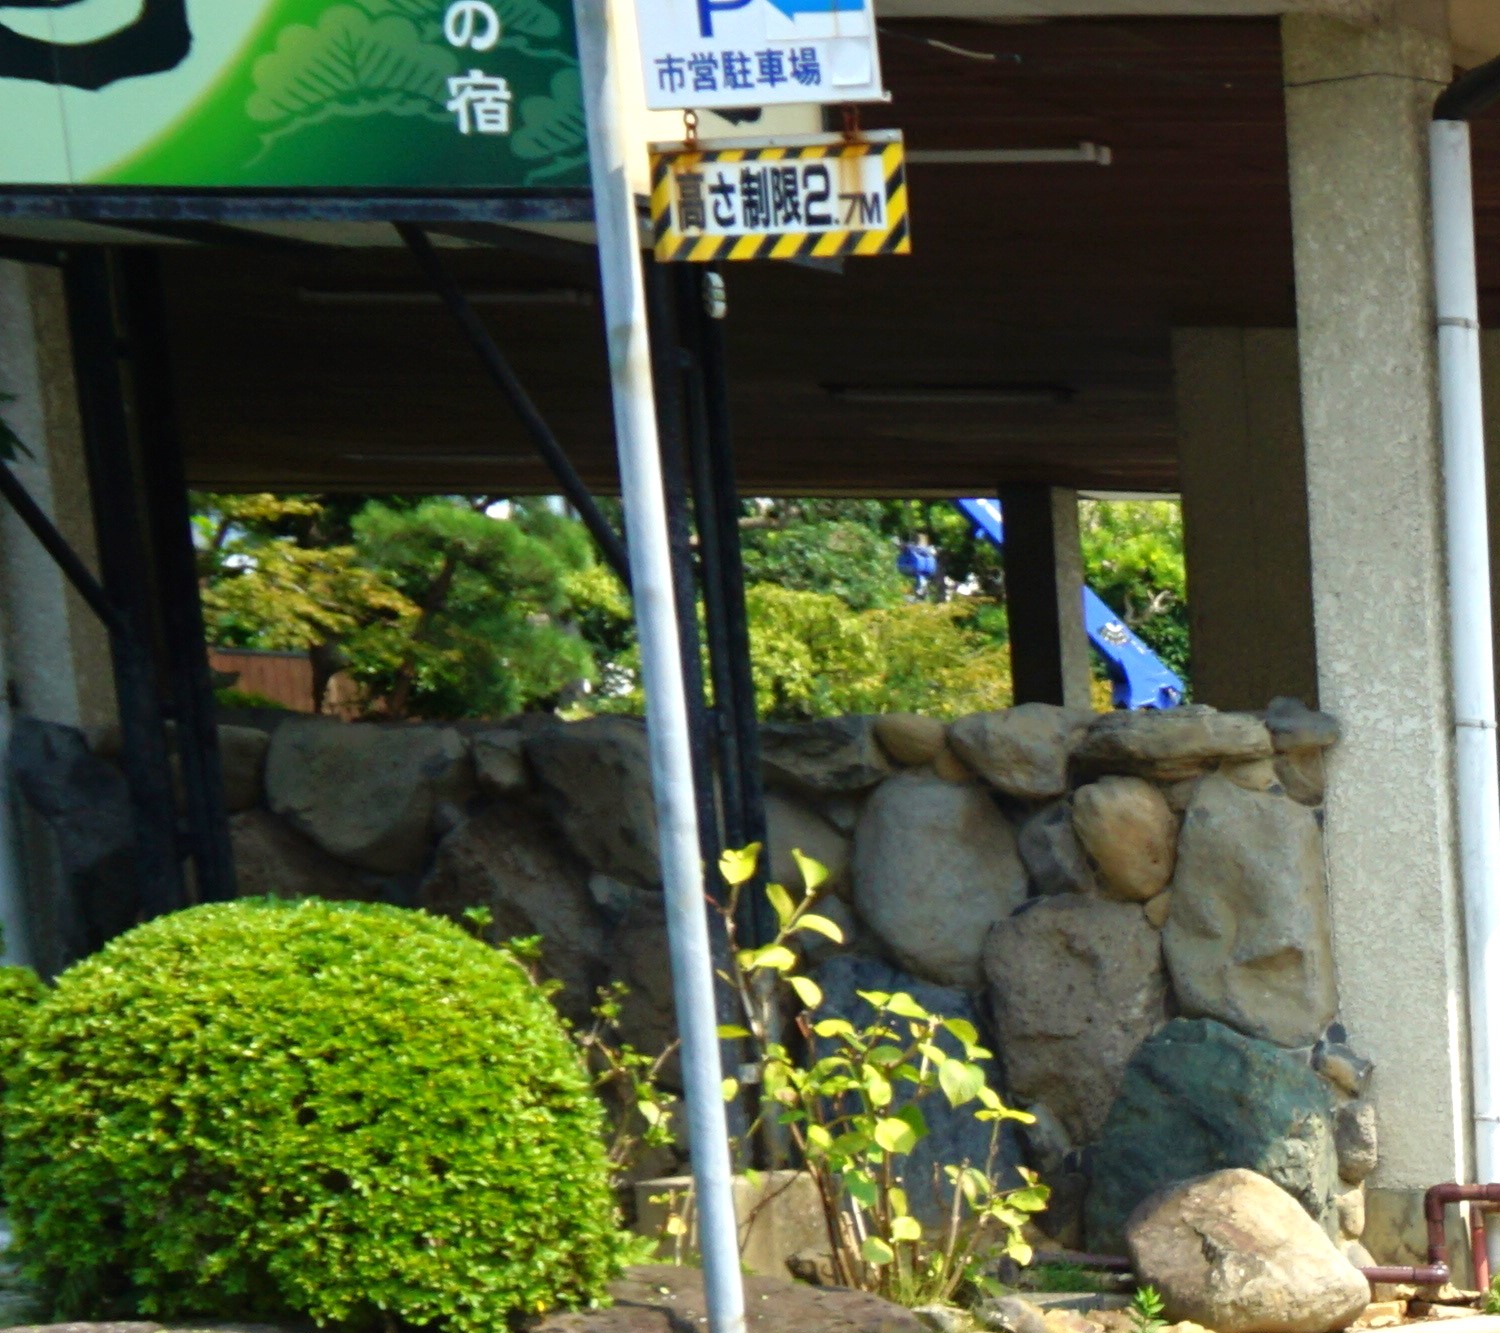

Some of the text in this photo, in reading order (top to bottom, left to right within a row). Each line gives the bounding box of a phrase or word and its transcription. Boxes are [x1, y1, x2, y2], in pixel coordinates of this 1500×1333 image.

[655, 47, 822, 93] 市営駐車場
[675, 163, 882, 231] 高さ制限2.7M
